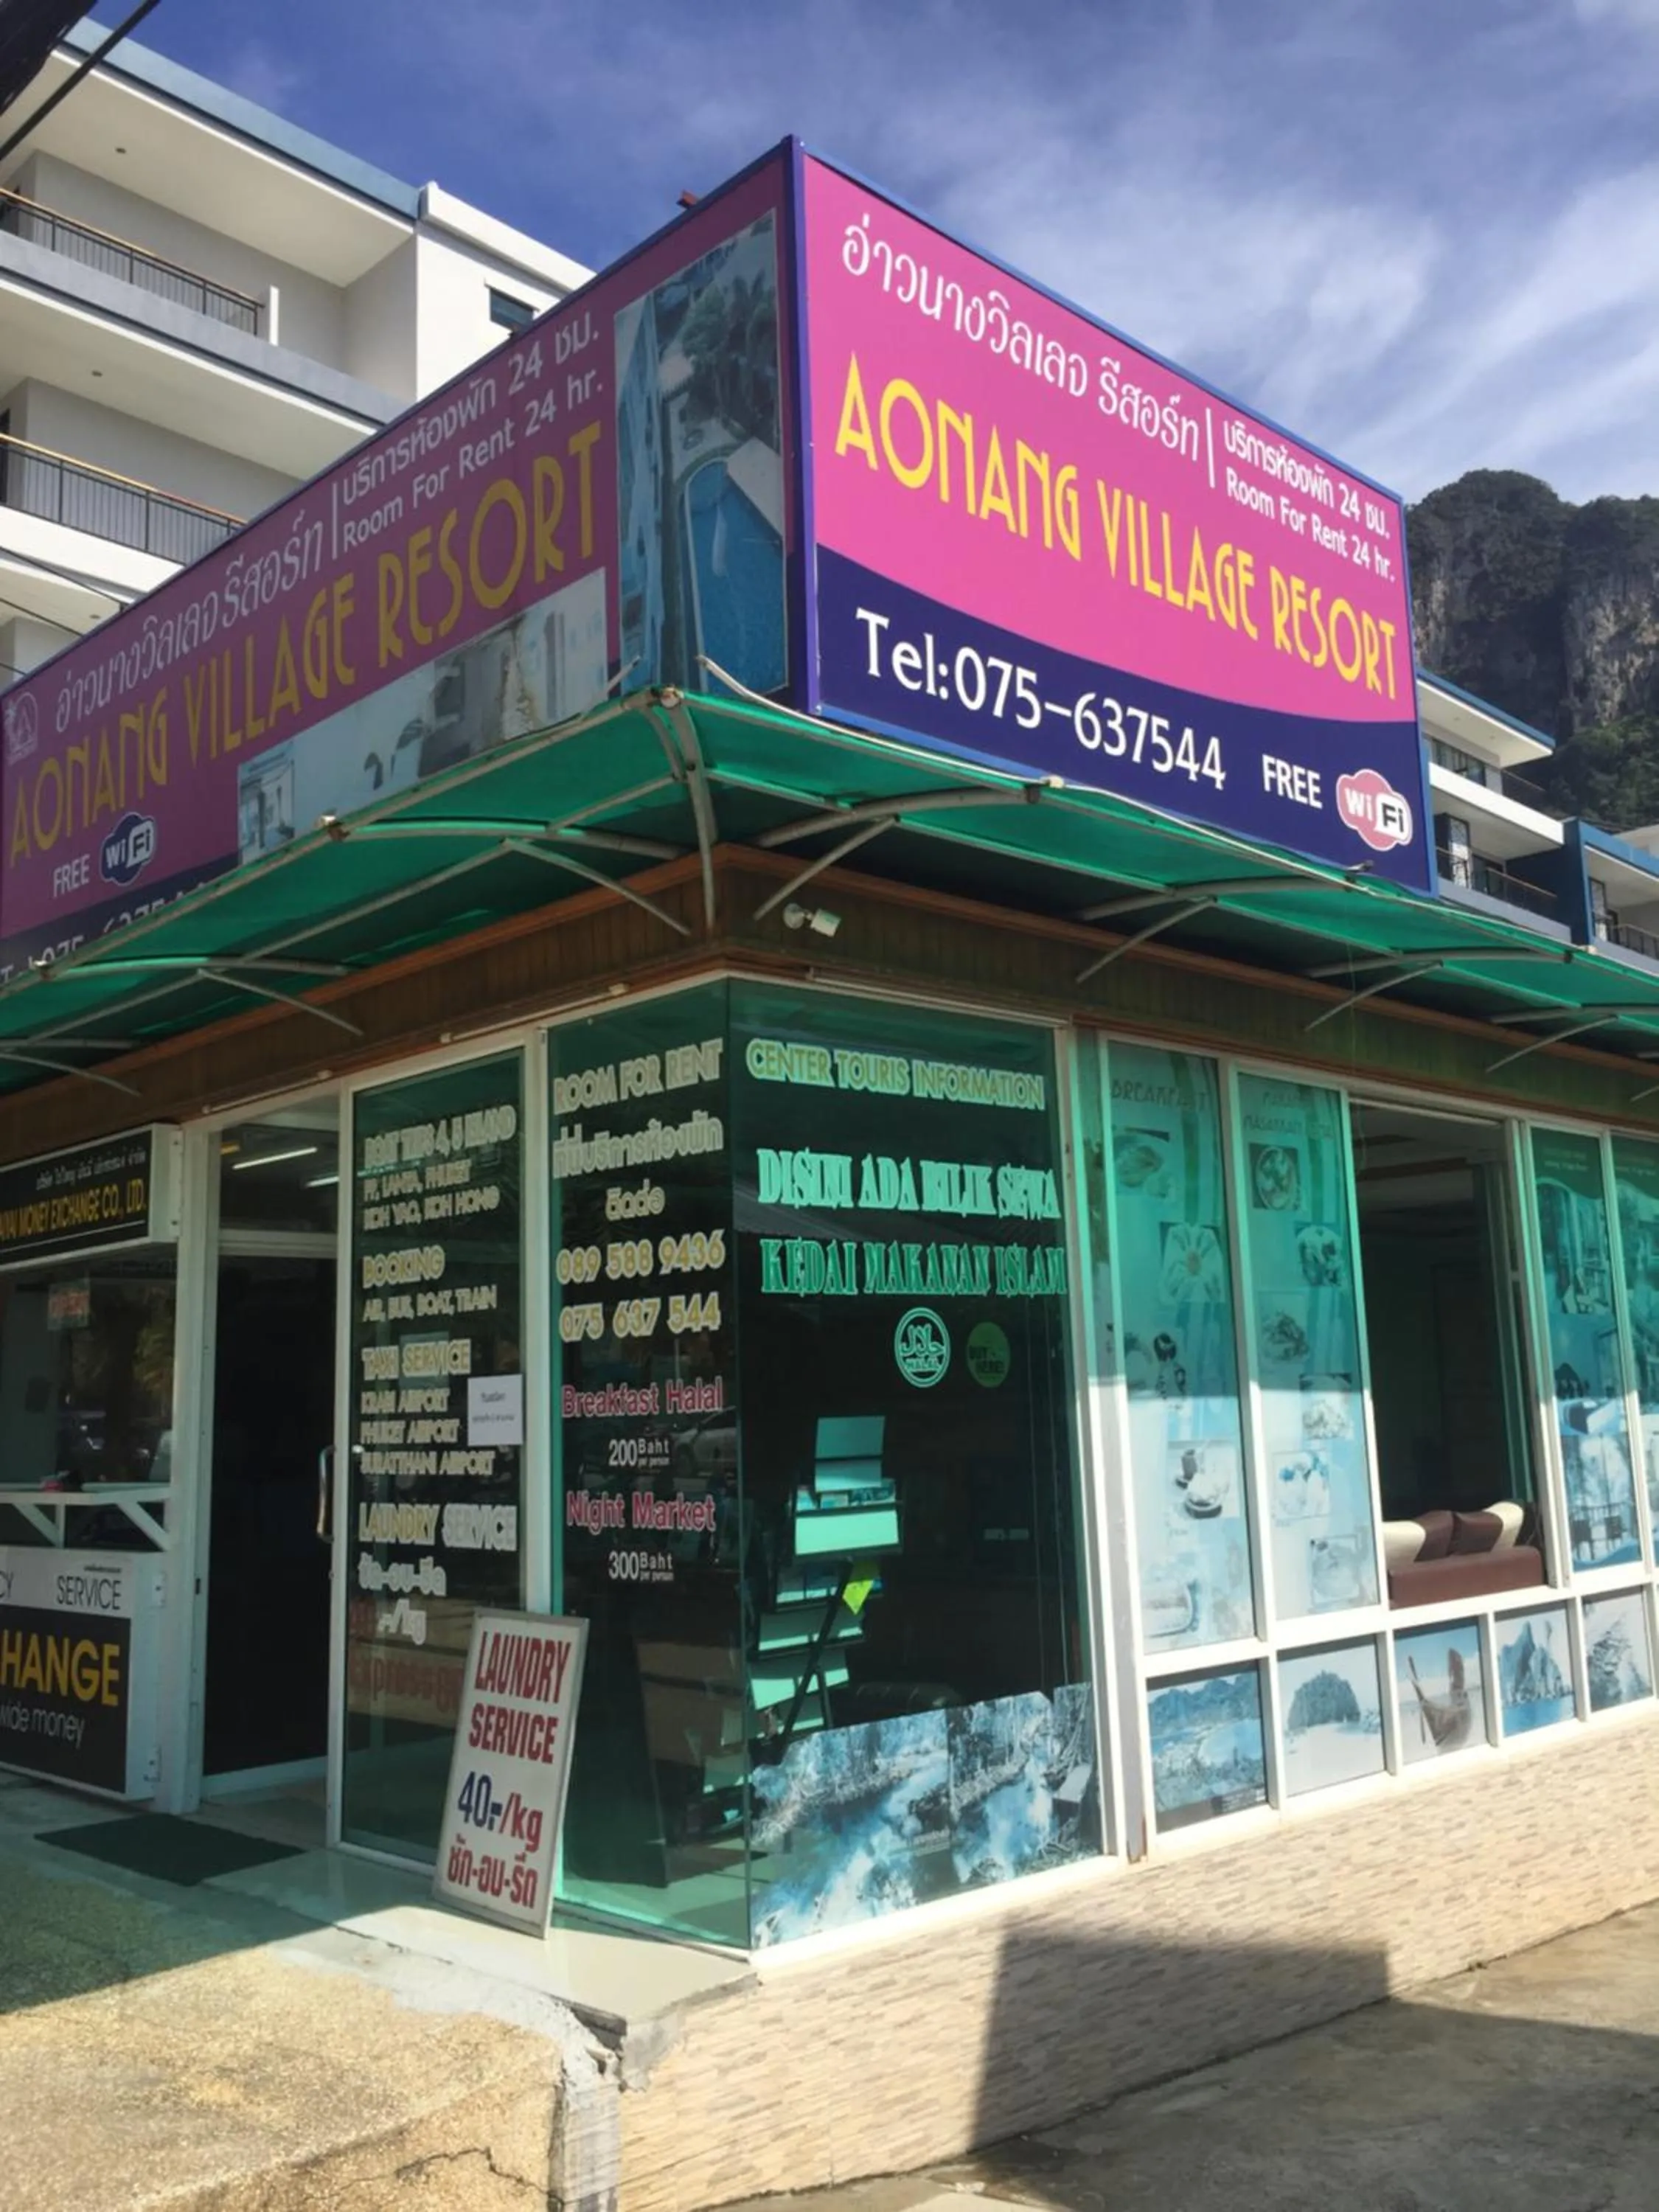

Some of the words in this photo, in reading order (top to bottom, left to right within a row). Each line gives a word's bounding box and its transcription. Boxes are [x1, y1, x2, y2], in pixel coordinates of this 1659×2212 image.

[509, 341, 543, 396] 24
[343, 496, 403, 552] Room
[413, 465, 450, 508] For
[459, 417, 515, 479] Rent
[524, 389, 557, 437] 24
[568, 369, 602, 411] hr.
[835, 349, 1082, 562] AONANG
[1096, 479, 1259, 641] VILLAGE
[1270, 566, 1397, 700] RESORT
[1225, 466, 1276, 519] Room
[1280, 496, 1307, 535] For
[1311, 512, 1348, 559] Rent
[1352, 535, 1370, 570] 24
[1374, 545, 1396, 583] hr.
[1339, 482, 1361, 523] 24
[10, 686, 168, 868] AONANG
[184, 571, 355, 769] VILLAGE
[378, 420, 601, 668] RESORT
[856, 608, 1227, 791] Tel:075-637544
[1262, 754, 1324, 810] FREE
[52, 854, 90, 898] FREE
[553, 1063, 618, 1116] ROOM
[620, 1054, 663, 1101] FOR
[665, 1037, 723, 1090] RENT
[746, 1037, 834, 1088] CENTER
[835, 1048, 911, 1096] TOURIS
[913, 1059, 1046, 1112] INFORMATION
[858, 1152, 919, 1211] ADA
[362, 1244, 445, 1290] BOOKING
[556, 1245, 602, 1285] 089
[658, 1228, 726, 1276] 9436
[760, 1236, 858, 1297] KEDAI
[559, 1302, 605, 1343] 075
[613, 1297, 661, 1339] 637
[667, 1291, 722, 1335] 544
[402, 1338, 472, 1377] SERVICE
[561, 1382, 660, 1419] Breakfast
[665, 1375, 724, 1415] Halal
[608, 1439, 639, 1467] 200
[639, 1437, 671, 1455] Baht
[358, 1501, 440, 1546] LAUNDRY
[442, 1503, 518, 1551] SERVICE
[566, 1489, 626, 1535] Night
[631, 1491, 717, 1531] Market
[57, 1574, 122, 1610] SERVICE
[608, 1551, 639, 1580] 300
[639, 1551, 673, 1571] Baht
[0, 1629, 120, 1707] HANGE
[474, 1631, 571, 1704] LAUNDRY
[32, 1708, 86, 1750] money
[468, 1702, 559, 1764] SERVICE
